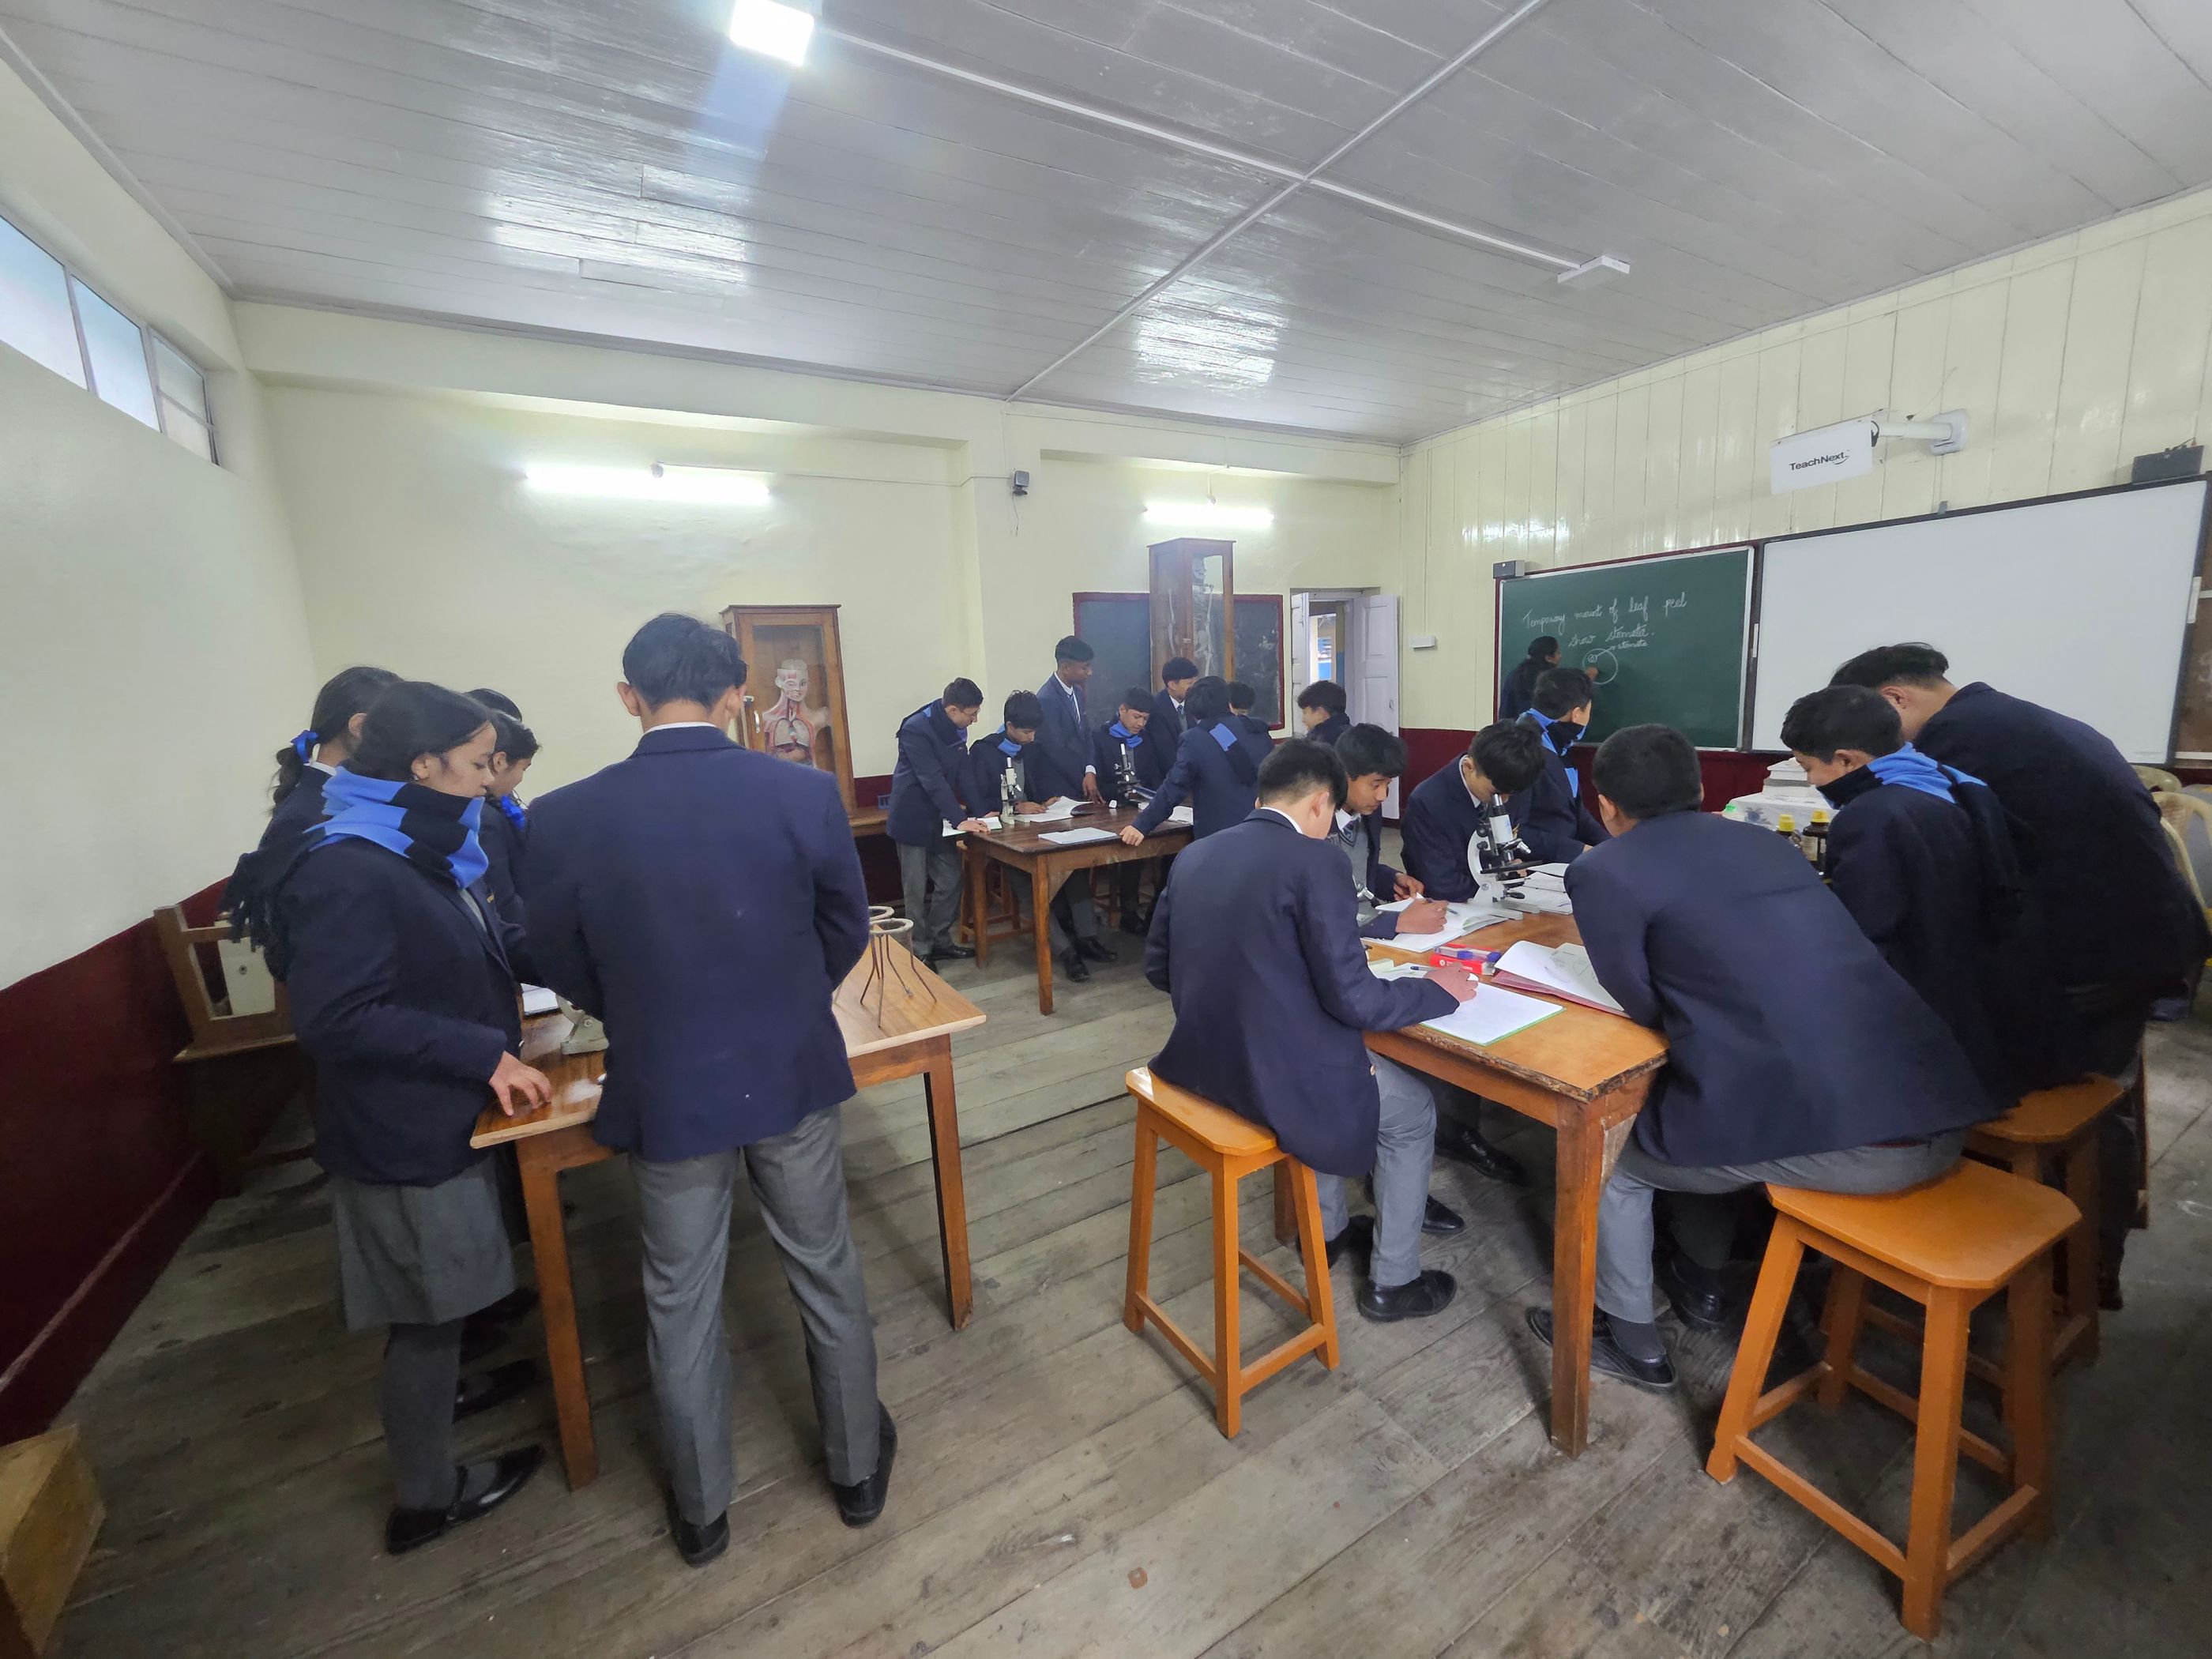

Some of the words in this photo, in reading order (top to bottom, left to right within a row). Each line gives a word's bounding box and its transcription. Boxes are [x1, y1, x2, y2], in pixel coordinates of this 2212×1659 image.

[1574, 604, 1603, 619] mount
[1609, 598, 1619, 624] of
[1628, 596, 1649, 622] leaf
[1663, 592, 1687, 617] peel
